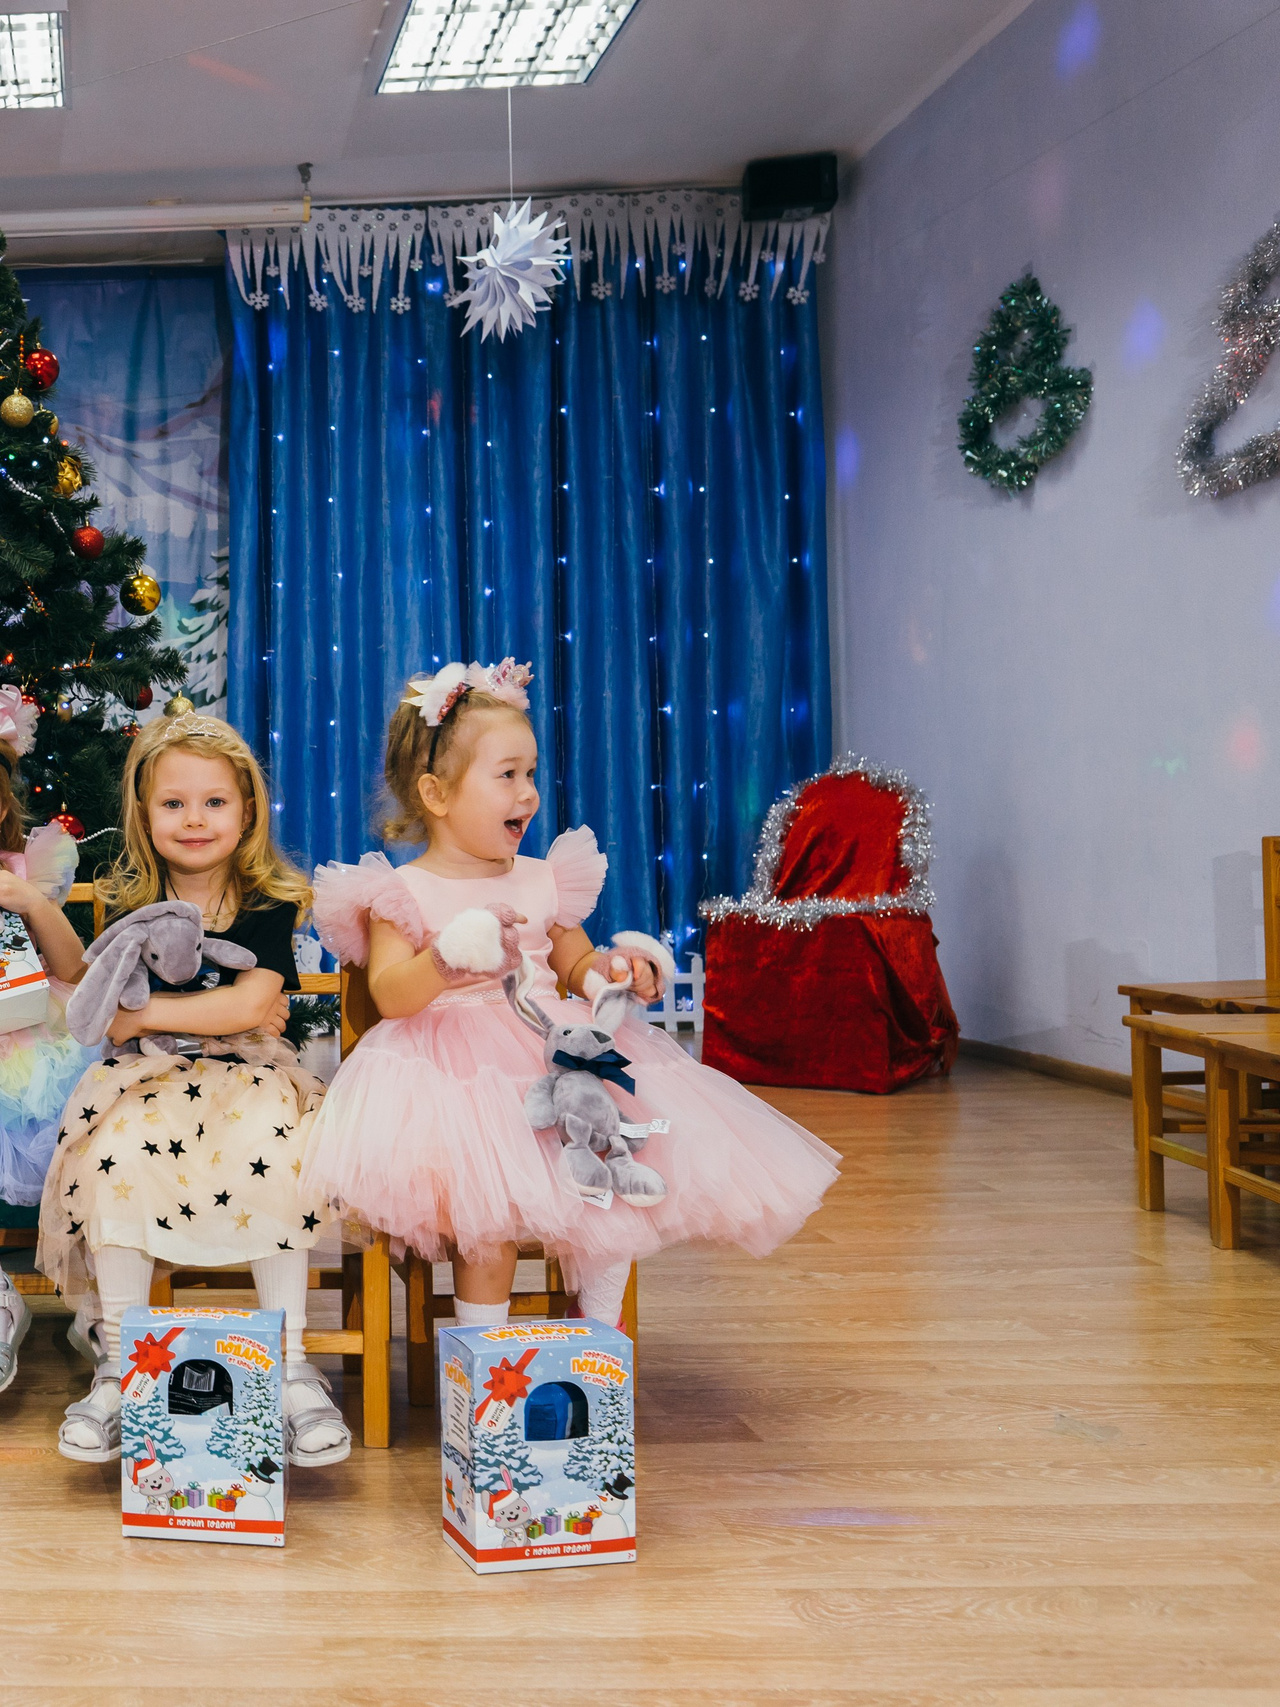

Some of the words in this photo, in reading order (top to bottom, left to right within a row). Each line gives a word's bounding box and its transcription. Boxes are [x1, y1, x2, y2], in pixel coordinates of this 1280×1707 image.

[482, 1327, 589, 1340] ПОДАРОК
[216, 1340, 274, 1371] ПОДАРОК
[572, 1359, 628, 1385] ПОДАРОК
[176, 1519, 204, 1528] НОВЫМ
